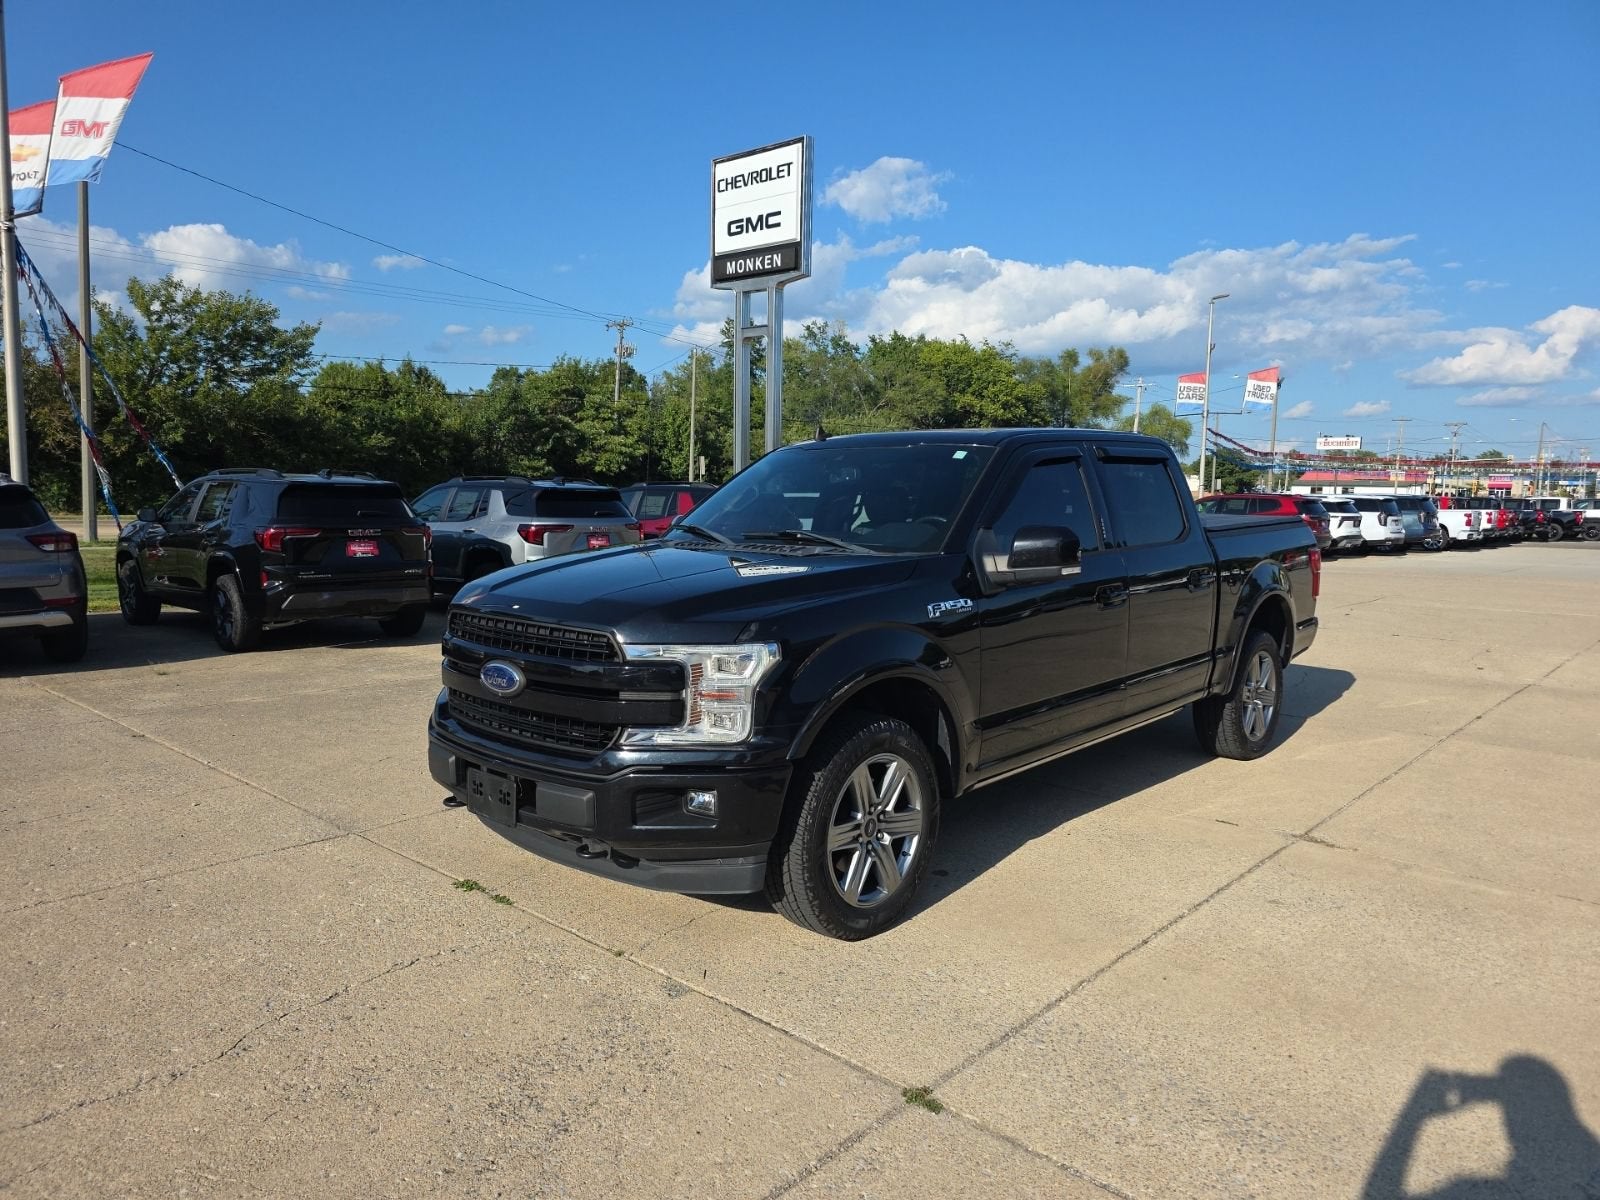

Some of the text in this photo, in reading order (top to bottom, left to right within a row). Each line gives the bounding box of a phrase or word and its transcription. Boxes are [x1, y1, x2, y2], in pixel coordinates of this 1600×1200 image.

[717, 161, 794, 193] CHEVROLET
[727, 210, 782, 237] GMC
[726, 253, 782, 275] MONKEN
[1178, 385, 1206, 394] USED
[1252, 383, 1272, 393] USED
[1178, 392, 1206, 401] CARS
[1247, 390, 1275, 401] TRUCKS
